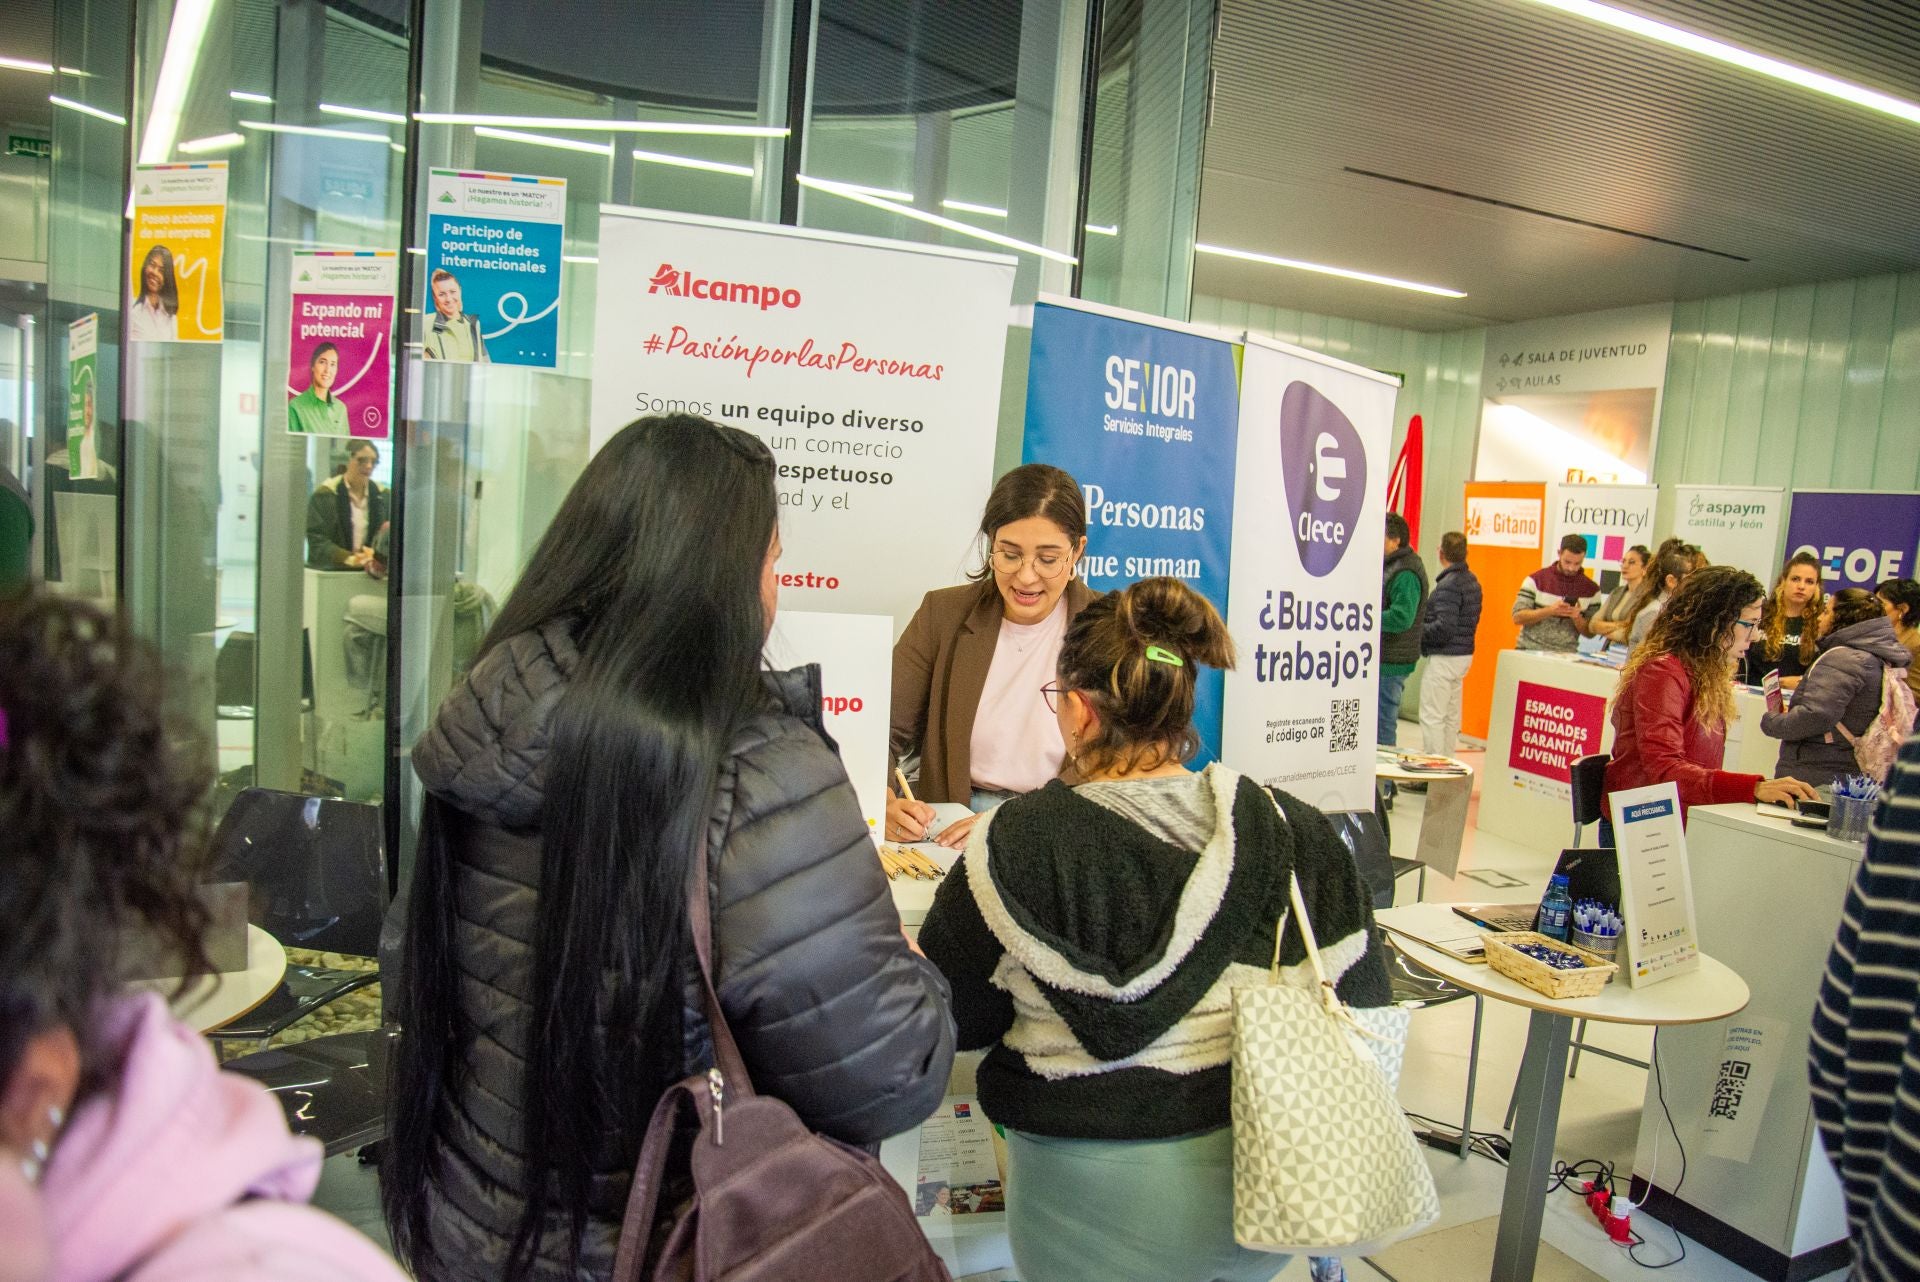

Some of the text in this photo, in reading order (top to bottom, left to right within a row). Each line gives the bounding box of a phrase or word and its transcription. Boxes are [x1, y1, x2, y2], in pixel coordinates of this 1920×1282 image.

[443, 223, 523, 240] Participo de
[441, 240, 540, 257] oportunidades
[441, 253, 547, 274] internacionales
[648, 263, 801, 311] Alcampo
[302, 301, 382, 320] Expando mi
[301, 322, 365, 340] potencial
[643, 325, 944, 380] #PasiónporlasPersonas
[1527, 343, 1648, 365] SALA DE JUVENTUD
[1524, 374, 1561, 387] AULAS
[636, 392, 924, 433] Somos un equipo diverso
[1104, 413, 1193, 443] Servicios Integrales
[771, 435, 797, 450] un
[806, 438, 903, 459] comercio
[776, 463, 893, 485] espetuoso
[812, 493, 824, 512] y
[831, 492, 850, 510] el
[1082, 484, 1205, 531] Personas
[1706, 503, 1766, 515] aspaym
[1298, 511, 1345, 544] Clece
[1493, 513, 1537, 535] Gitano
[1563, 499, 1650, 534] foremcyl
[1688, 518, 1764, 530] castilla y león
[775, 572, 840, 590] estro
[1077, 555, 1201, 588] que suman
[1259, 589, 1374, 632] ¿Buscas
[1255, 640, 1373, 688] trabajo?
[1292, 716, 1326, 726] escaneando
[1525, 699, 1574, 721] ESPACIO
[1266, 726, 1325, 743] el código QR
[1523, 715, 1588, 741] ENTIDADES
[1521, 730, 1584, 756] GARANTÍA
[1519, 746, 1567, 770] JUVENIL
